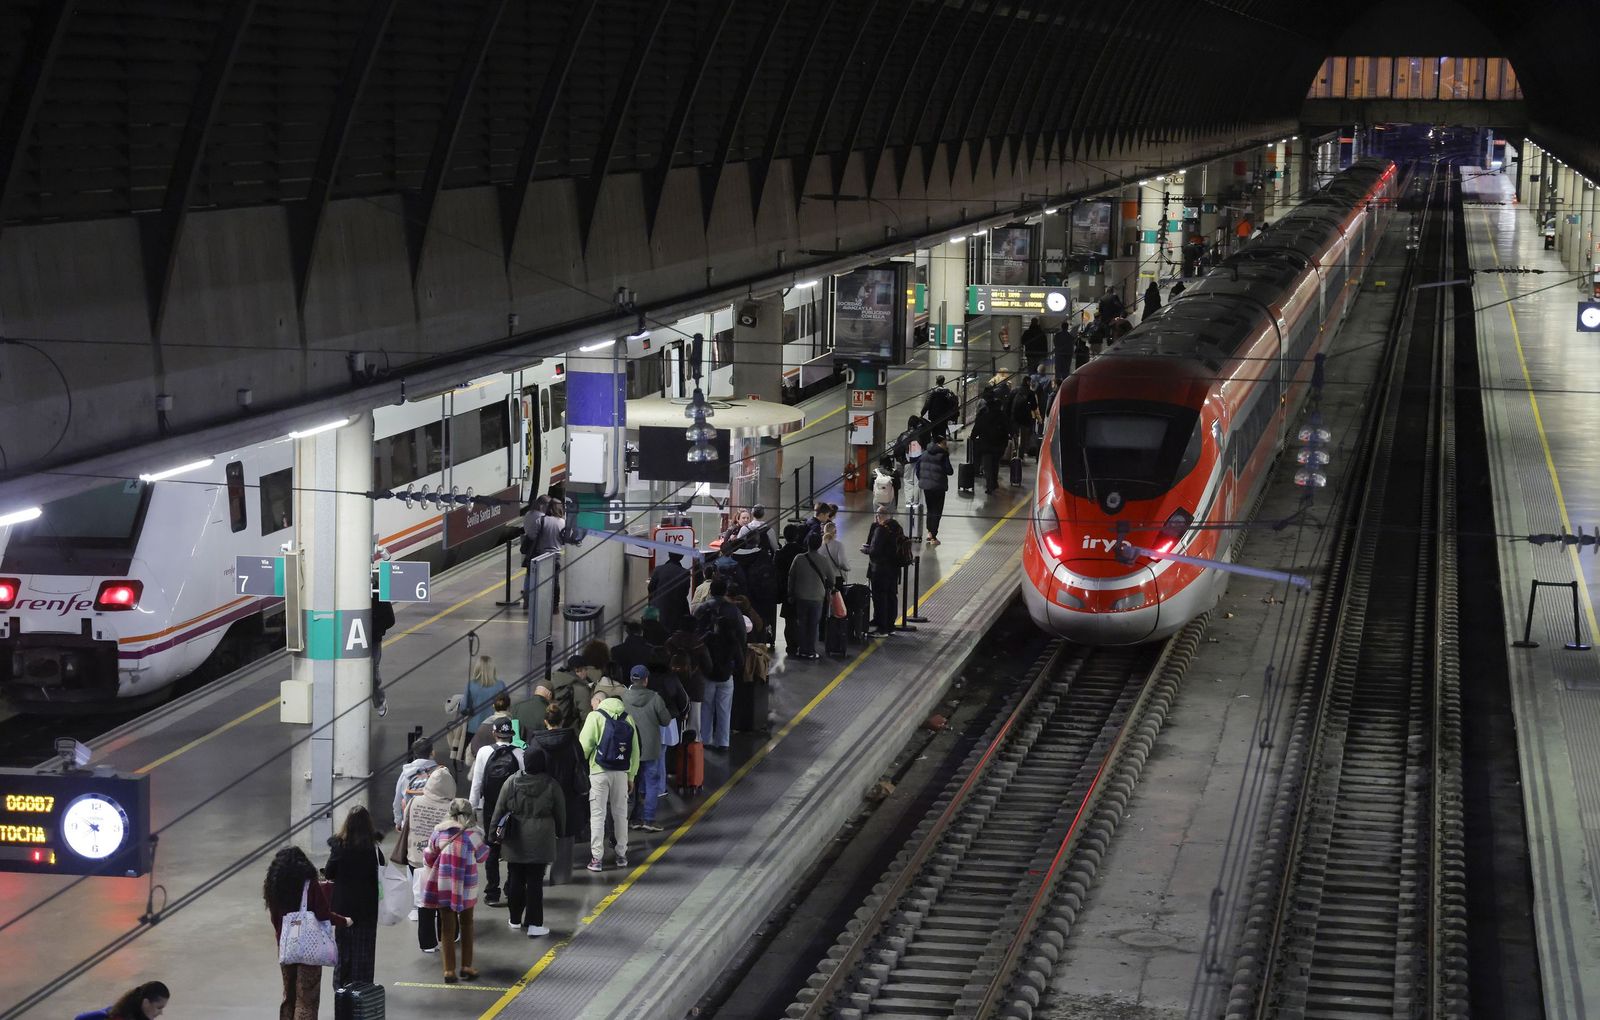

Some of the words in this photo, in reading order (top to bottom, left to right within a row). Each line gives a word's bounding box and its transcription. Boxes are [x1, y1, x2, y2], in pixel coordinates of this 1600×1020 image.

[977, 300, 985, 311] 6
[928, 326, 936, 342] E
[954, 328, 963, 343] E
[846, 368, 855, 384] D
[878, 368, 887, 385] D
[467, 511, 480, 528] Sevilla
[480, 508, 491, 522] Santa
[609, 499, 623, 524] B
[664, 532, 684, 544] iryo
[238, 575, 249, 592] 7
[415, 581, 427, 599] 6
[15, 593, 93, 616] renfe
[345, 618, 368, 650] A
